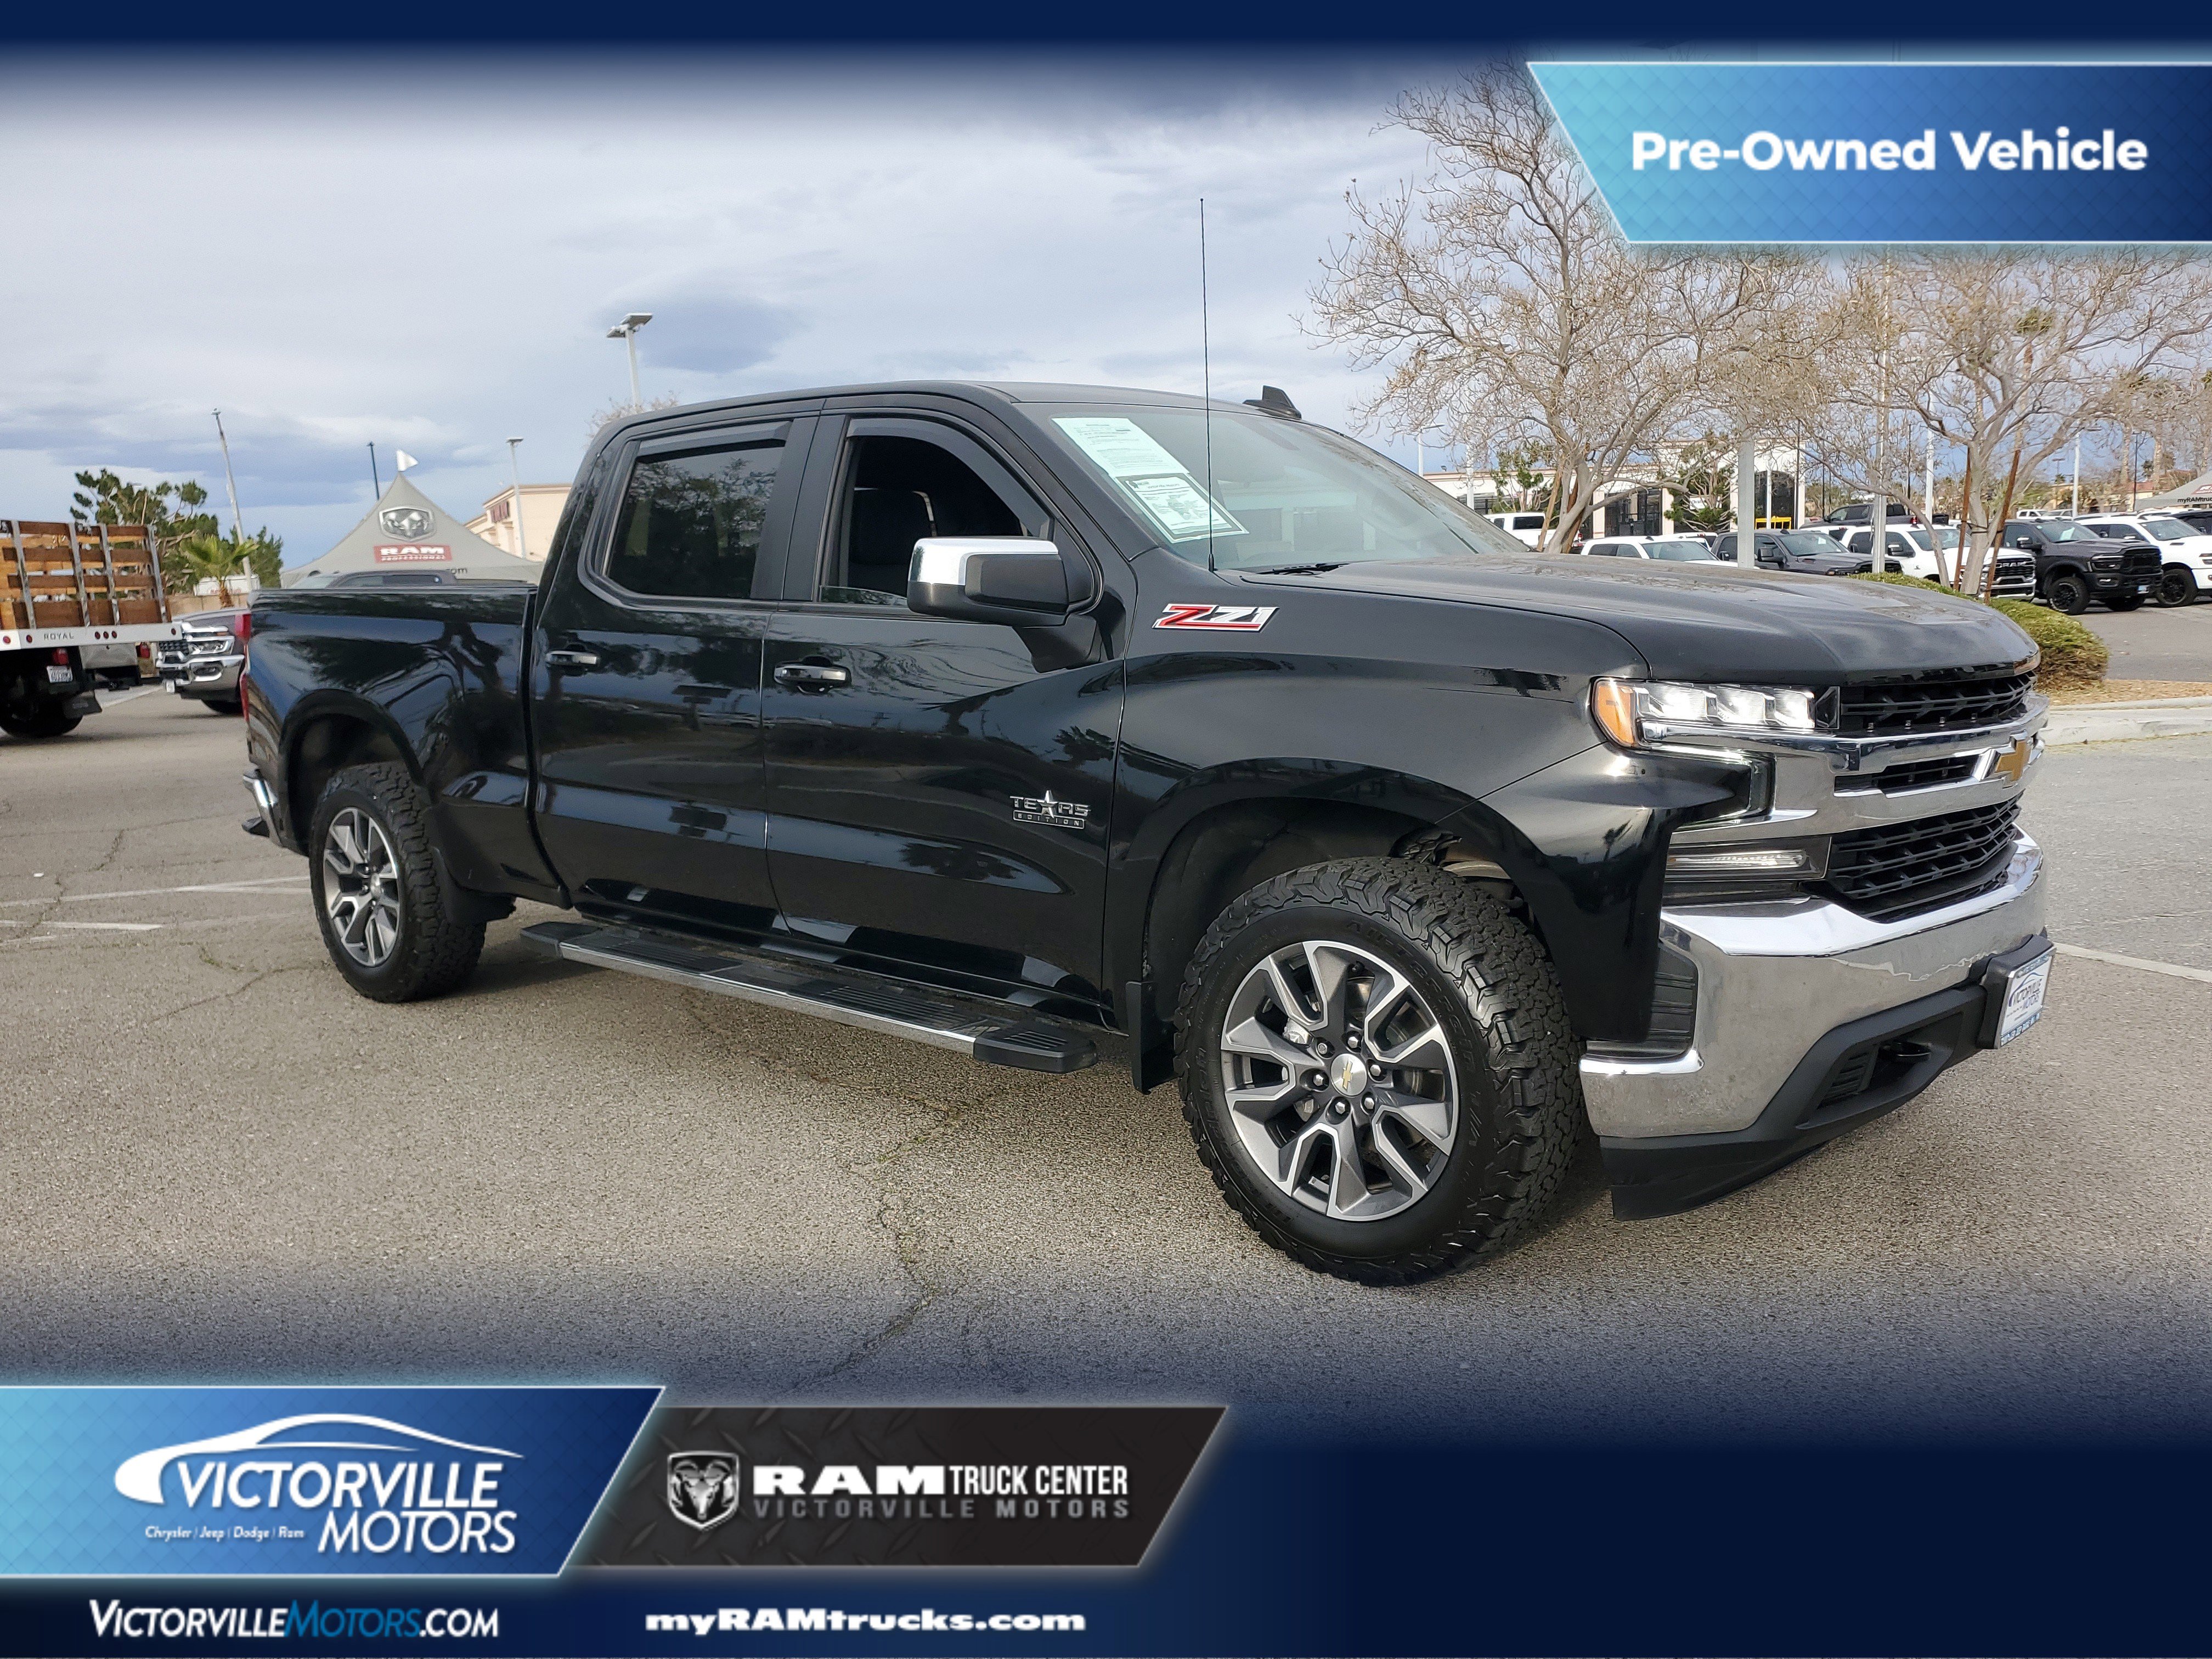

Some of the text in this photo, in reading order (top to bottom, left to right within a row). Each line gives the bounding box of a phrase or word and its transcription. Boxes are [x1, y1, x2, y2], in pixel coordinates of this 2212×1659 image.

[380, 546, 444, 555] RAM
[1152, 603, 1279, 632] Z71
[44, 632, 75, 640] ROYAL
[1018, 813, 1080, 826] EDITION
